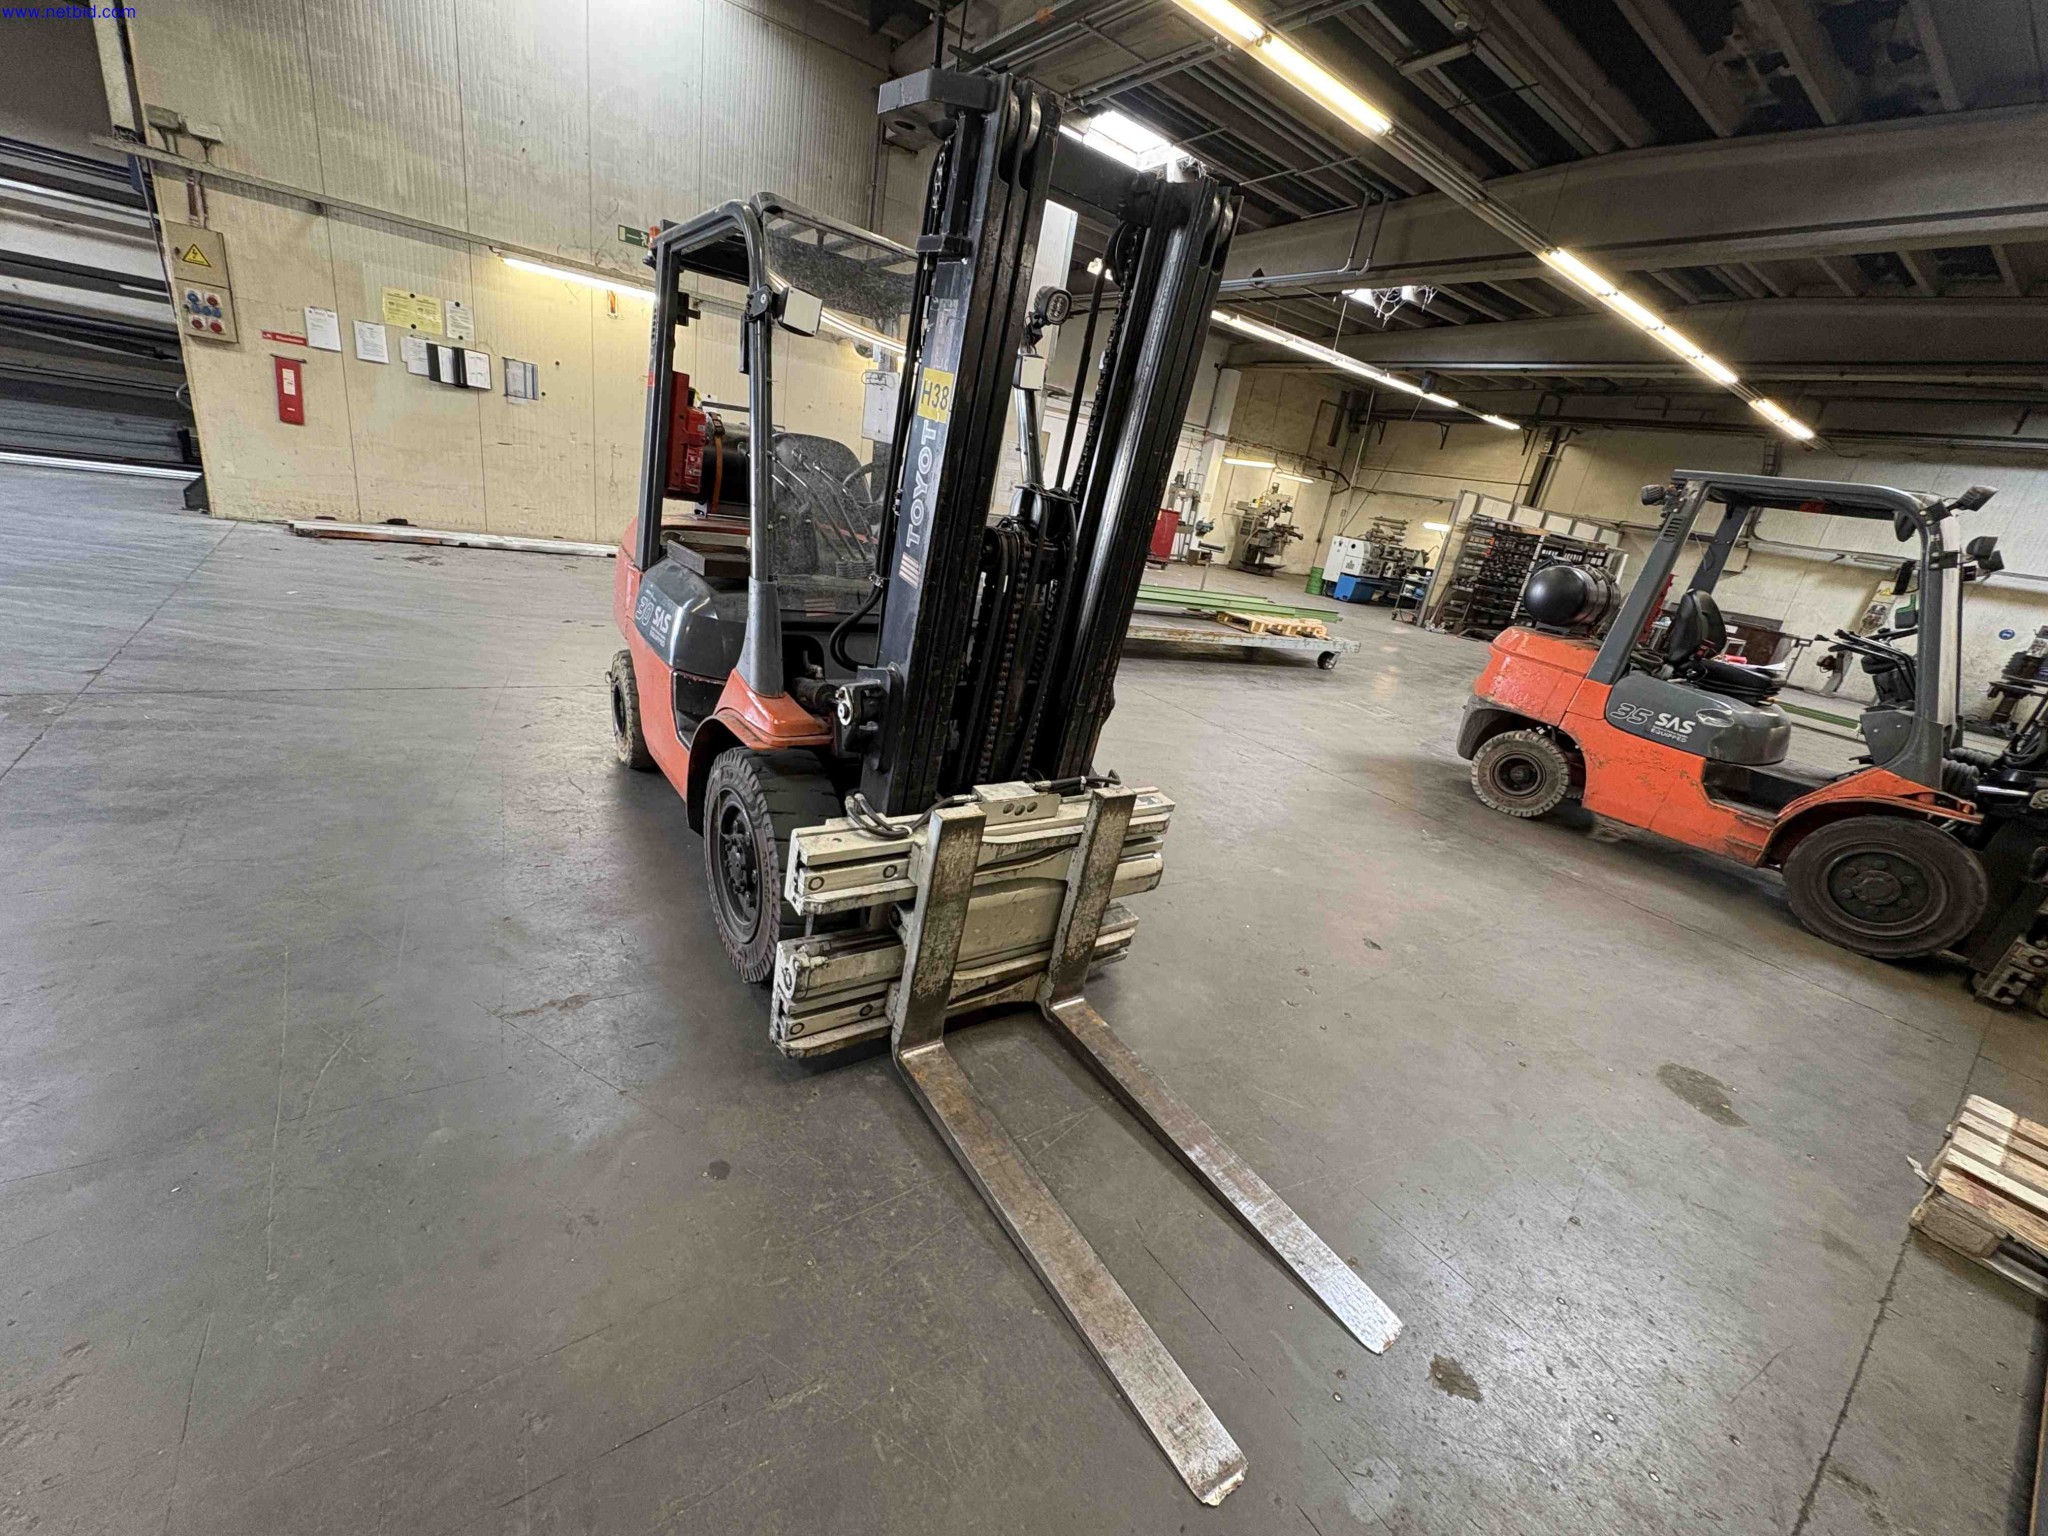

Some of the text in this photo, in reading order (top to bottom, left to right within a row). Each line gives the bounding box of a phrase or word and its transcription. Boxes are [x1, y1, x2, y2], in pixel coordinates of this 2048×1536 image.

[921, 379, 950, 411] H38
[905, 418, 937, 548] TOYOT
[635, 595, 655, 626] 30
[652, 605, 672, 634] SAS
[1610, 702, 1655, 725] 35
[1654, 712, 1696, 735] SAS
